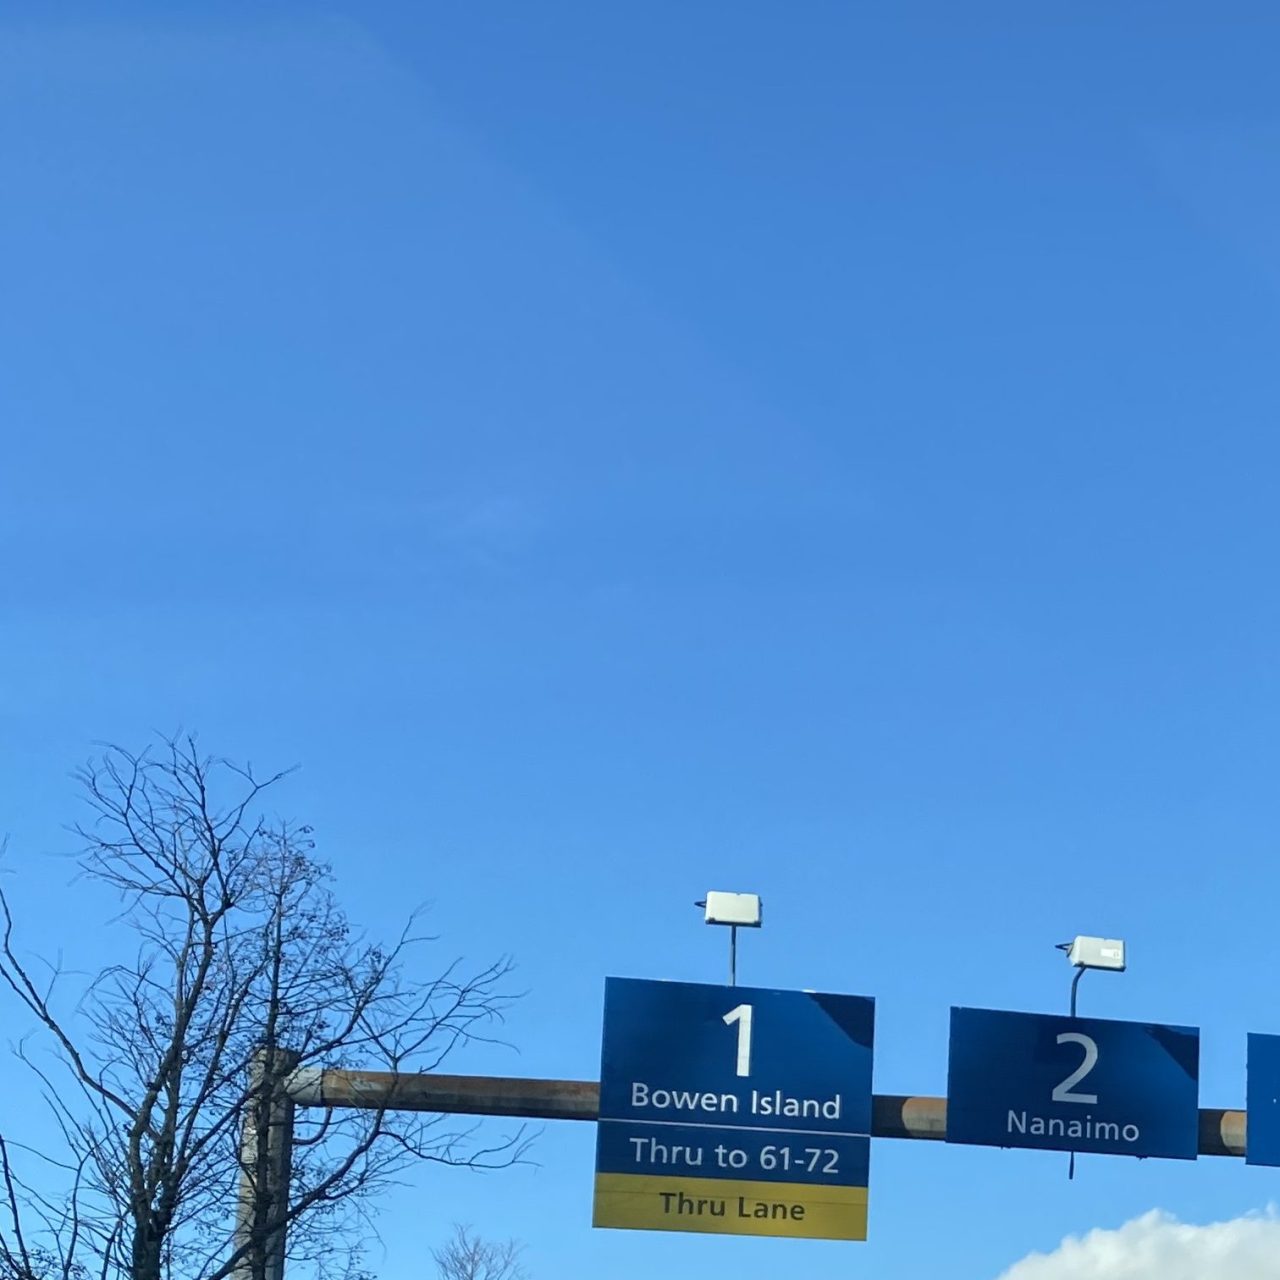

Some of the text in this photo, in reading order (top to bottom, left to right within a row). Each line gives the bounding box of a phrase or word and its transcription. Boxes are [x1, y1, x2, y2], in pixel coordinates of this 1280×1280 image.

[722, 1004, 753, 1077] 1
[1051, 1032, 1099, 1105] 2
[631, 1082, 841, 1119] Bowen Island
[1007, 1109, 1140, 1142] Nanaimo
[629, 1137, 840, 1174] Thru to 61-72
[658, 1191, 806, 1221] Thru Lane
